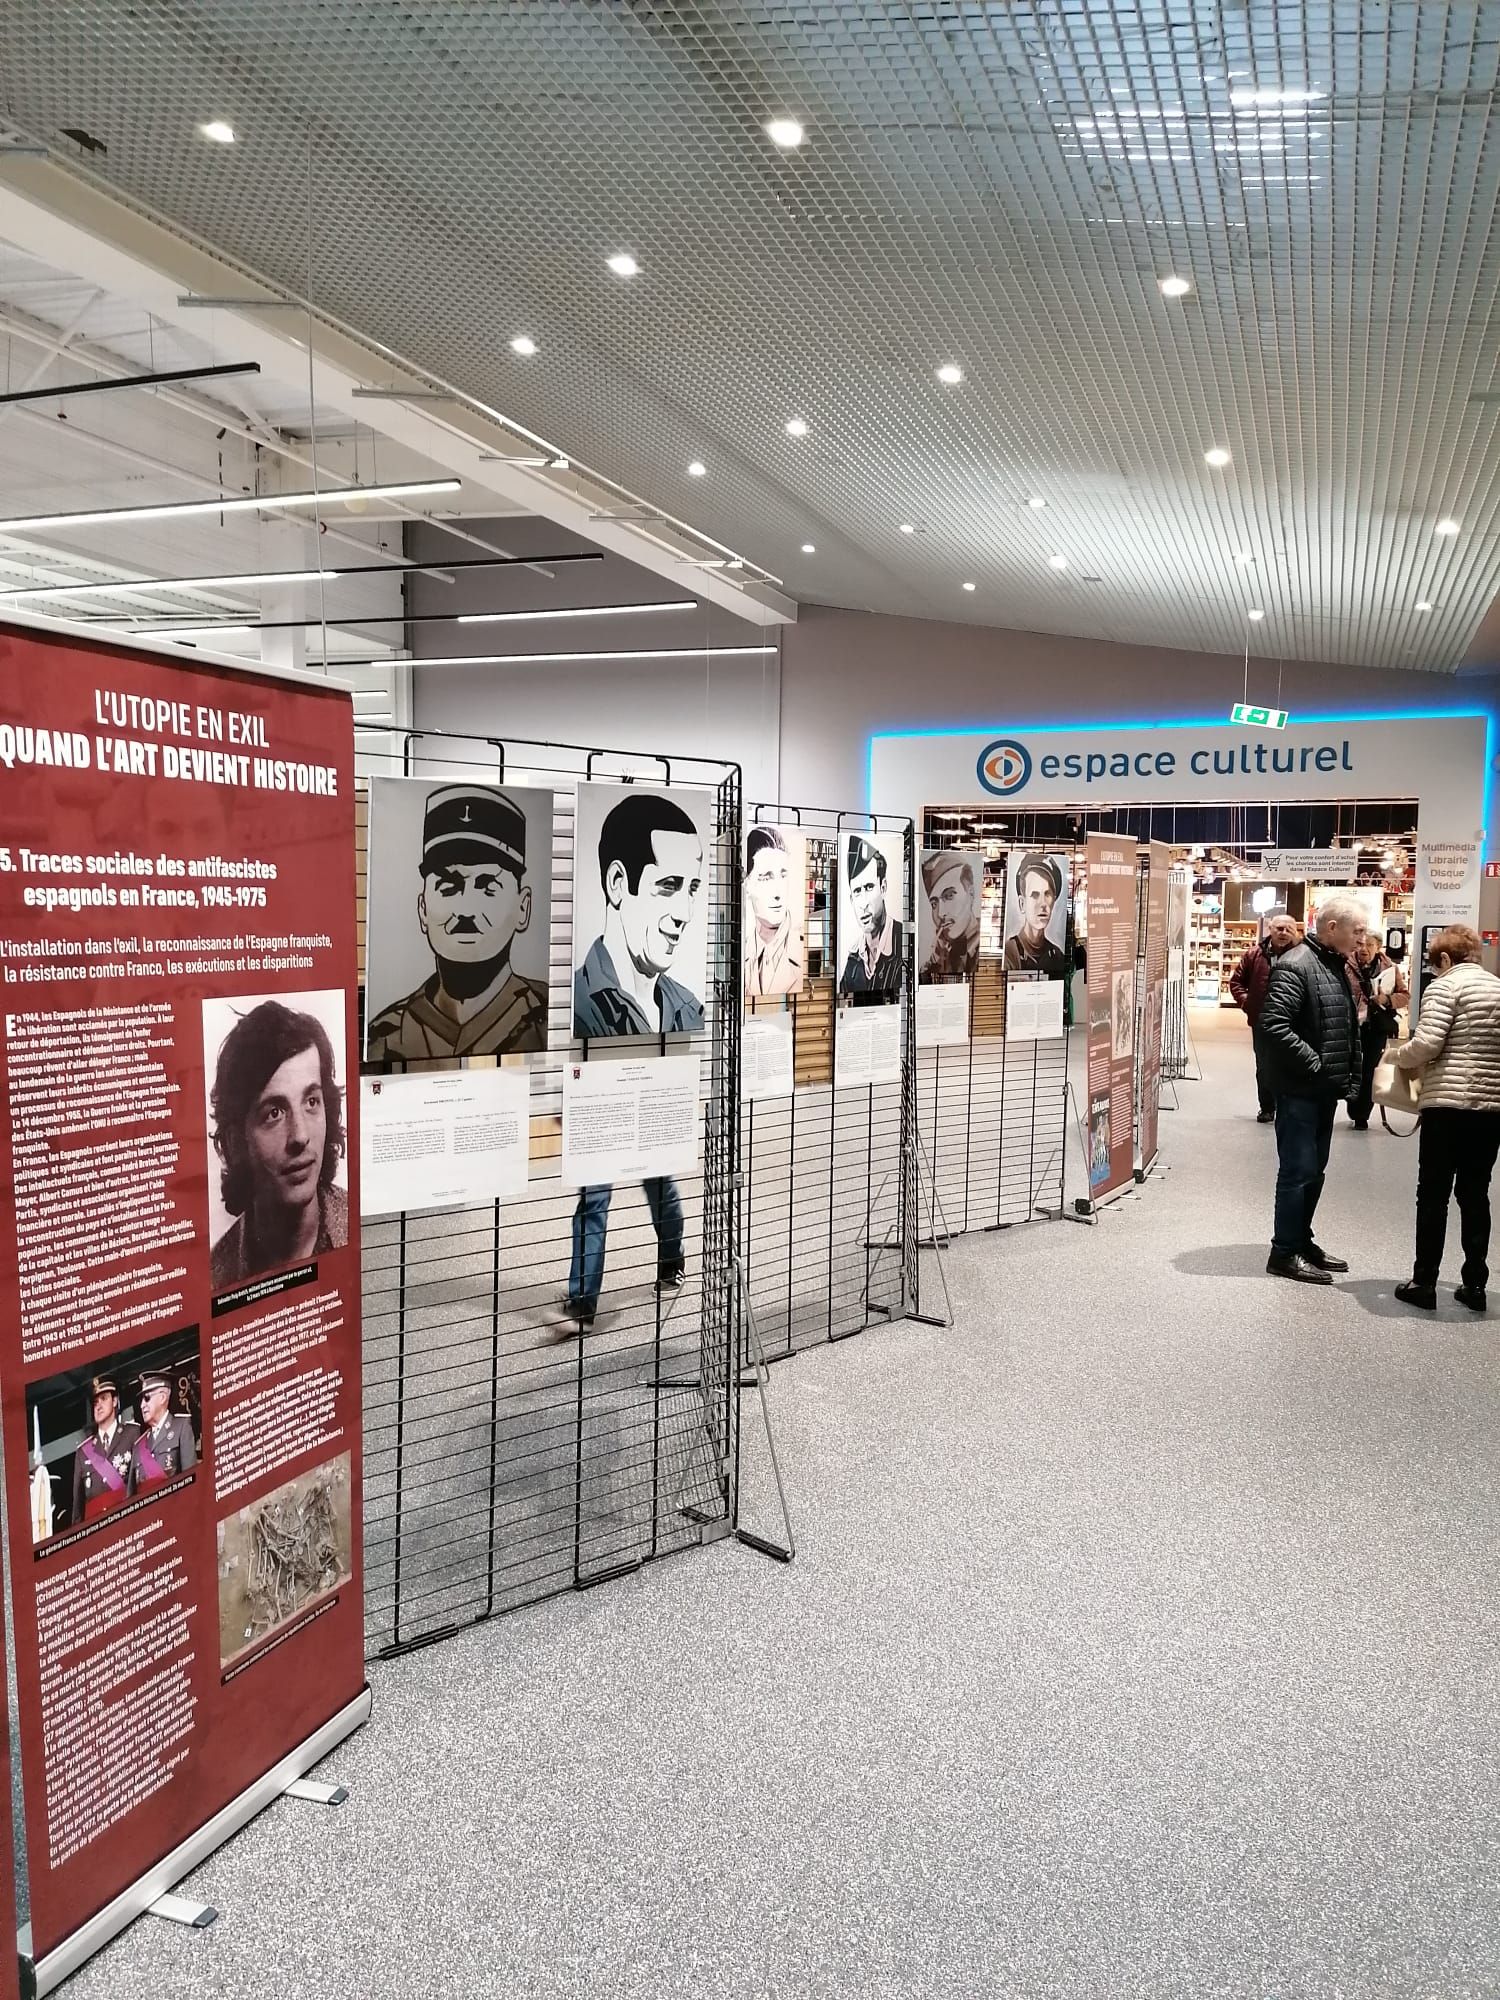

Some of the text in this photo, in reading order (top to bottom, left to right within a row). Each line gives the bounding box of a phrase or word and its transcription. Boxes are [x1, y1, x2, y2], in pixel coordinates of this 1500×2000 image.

[96, 690, 269, 748] L'UTOPIE EN EXIL
[0, 724, 337, 796] QUAND L'ART DEVIENT HISTOIRE
[1040, 740, 1353, 782] espace culturel
[0, 848, 277, 879] 5. Traces sociales des antifascistes
[1428, 856, 1468, 864] Librairie
[1431, 870, 1464, 878] Disque
[24, 883, 266, 912] espagnols en France, 1945-1975
[0, 933, 332, 957] L'installation dans l'exil, la reconnaissance de l'Espagne franquiste,
[4, 954, 313, 982] la résistance contre Franco, les exécutions et les disparitions
